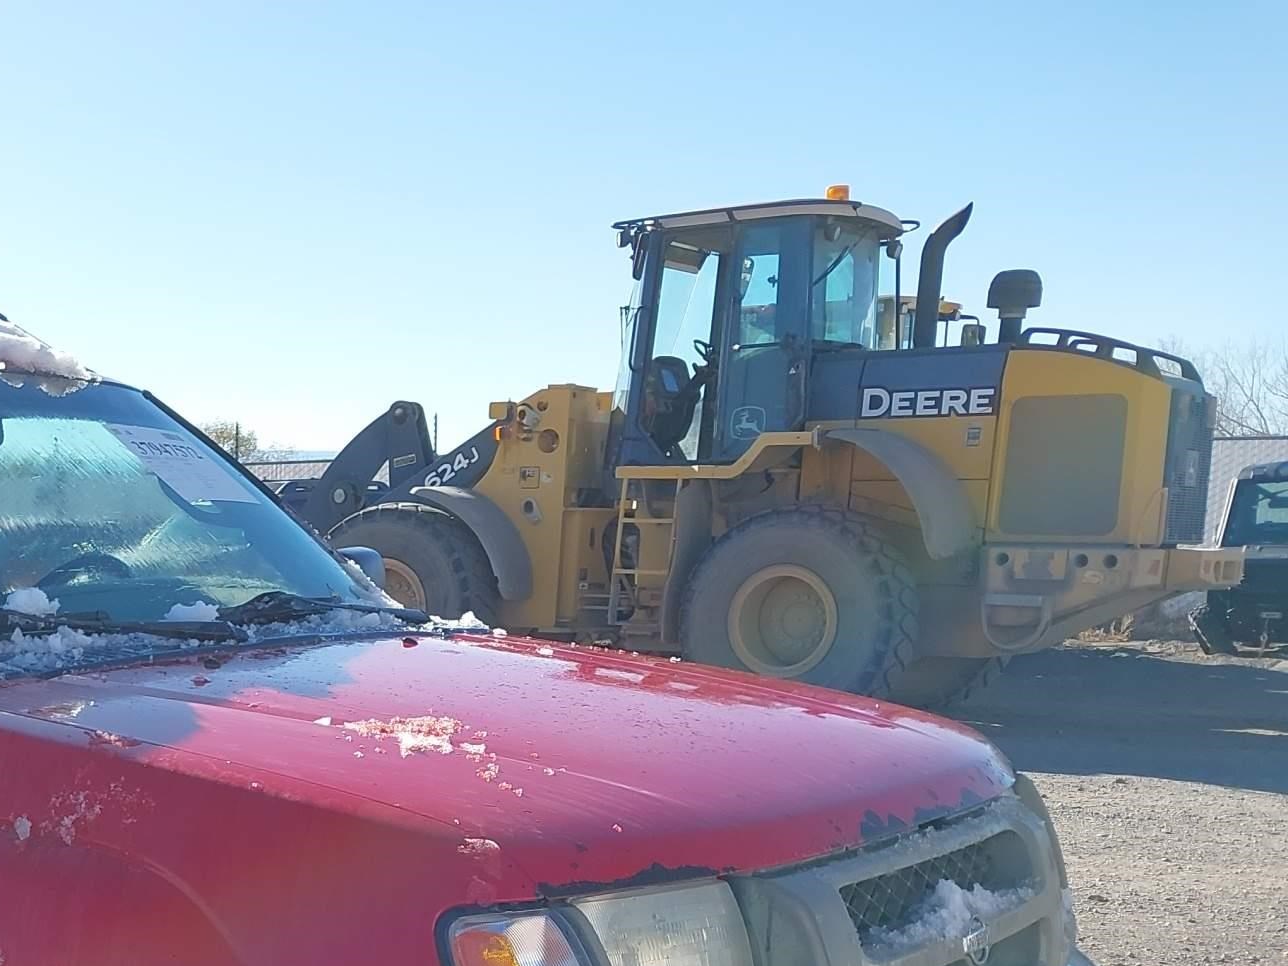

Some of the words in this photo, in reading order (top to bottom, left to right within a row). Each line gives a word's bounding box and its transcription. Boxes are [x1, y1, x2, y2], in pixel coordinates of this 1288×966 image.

[861, 387, 995, 417] DEERE
[131, 441, 204, 459] 37947572
[424, 446, 480, 487] 624J
